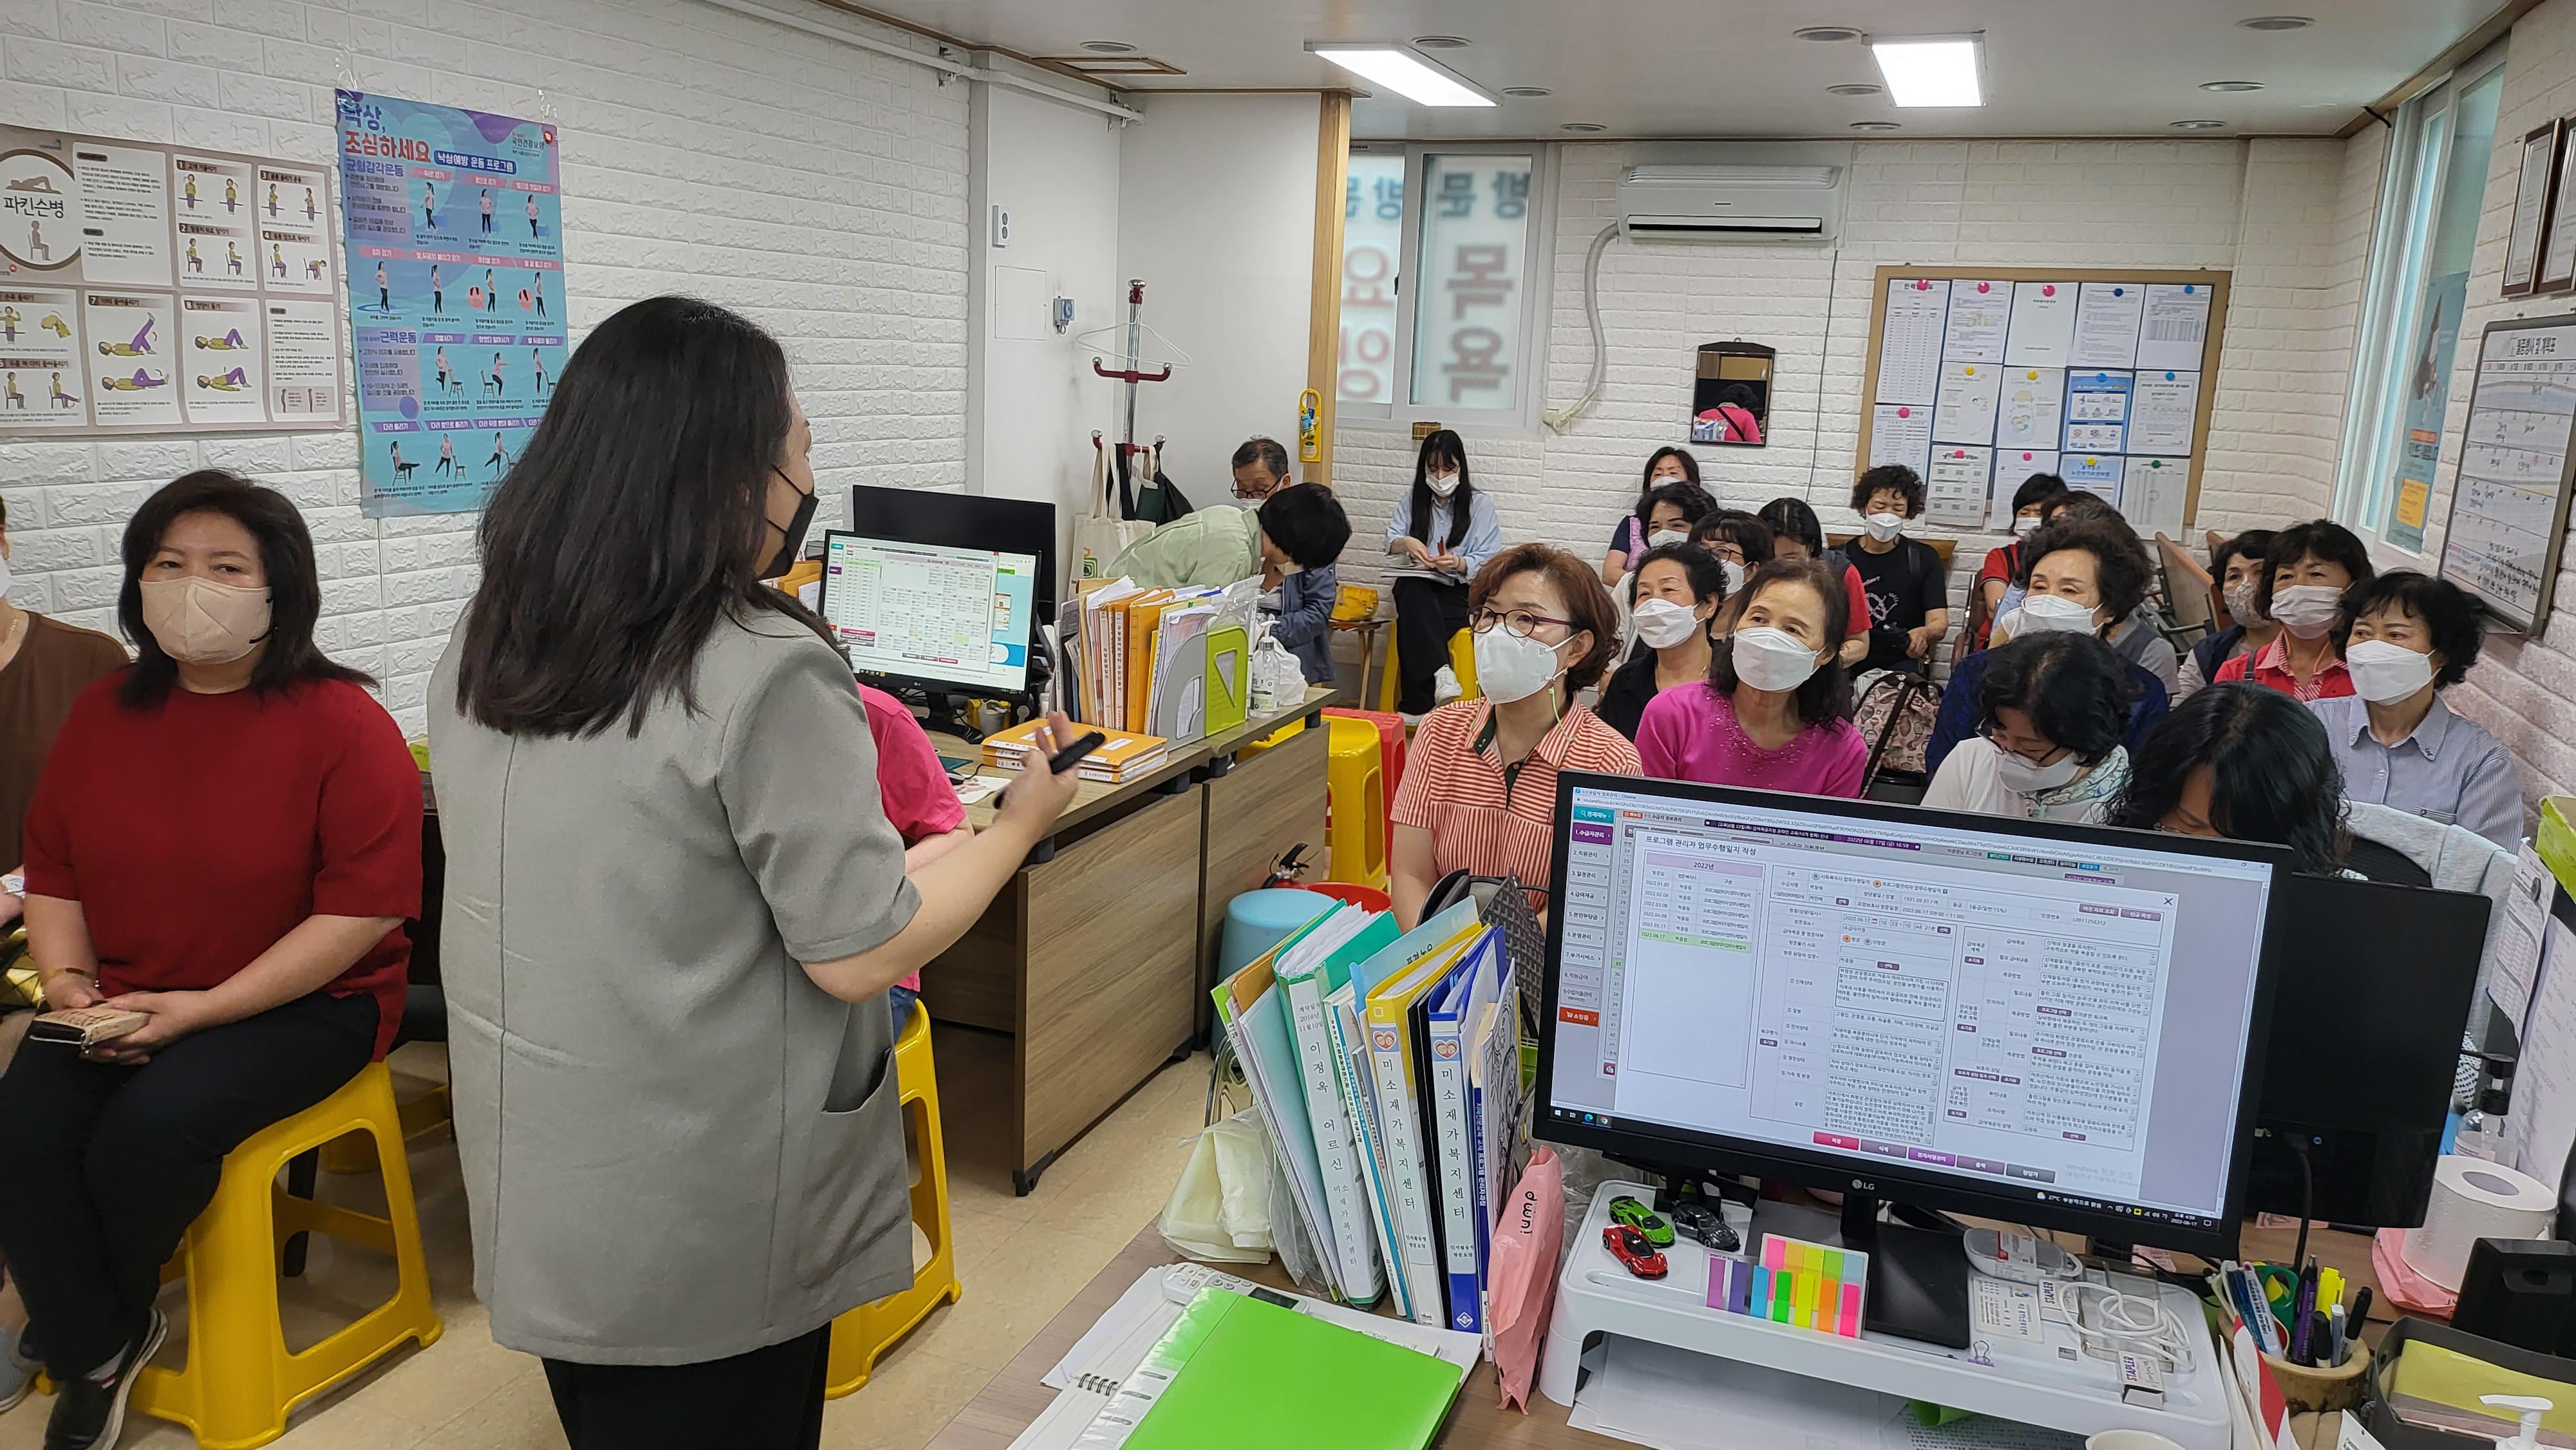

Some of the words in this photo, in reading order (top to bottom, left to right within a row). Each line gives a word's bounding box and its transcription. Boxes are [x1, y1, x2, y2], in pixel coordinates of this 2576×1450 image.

[345, 131, 431, 163] 조심하세요
[346, 159, 404, 177] 균형감각운동
[438, 153, 468, 165] 낙상예방
[471, 157, 484, 168] 운동
[487, 159, 513, 173] 프로그램
[3, 196, 64, 219] 파킨슨병
[380, 331, 417, 344] 근력운동
[1575, 829, 1604, 838] 1.수급자관리
[1573, 849, 1597, 858] 2.직원관리
[1645, 836, 1672, 846] 프로그램
[1674, 839, 1695, 849] 관리자
[1698, 842, 1739, 854] 업무수행일지
[1741, 847, 1756, 856] 작성
[1571, 870, 1596, 879] 3.일정관리
[1693, 862, 1714, 870] 2022년
[1570, 890, 1594, 899] 4.급여제공
[1567, 931, 1591, 940] 6.운영관리
[1566, 951, 1594, 961] 7.부가서비스
[1300, 1012, 1320, 1022] 2018년
[1310, 1042, 1328, 1093] 이정옥
[1324, 1119, 1343, 1171] 어르신
[1383, 1059, 1415, 1210] 미소재가복지센터
[1441, 1068, 1465, 1219] 미소재가복지센터
[2043, 1281, 2054, 1306] STAPLER
[2125, 1355, 2138, 1382] STAPLER
